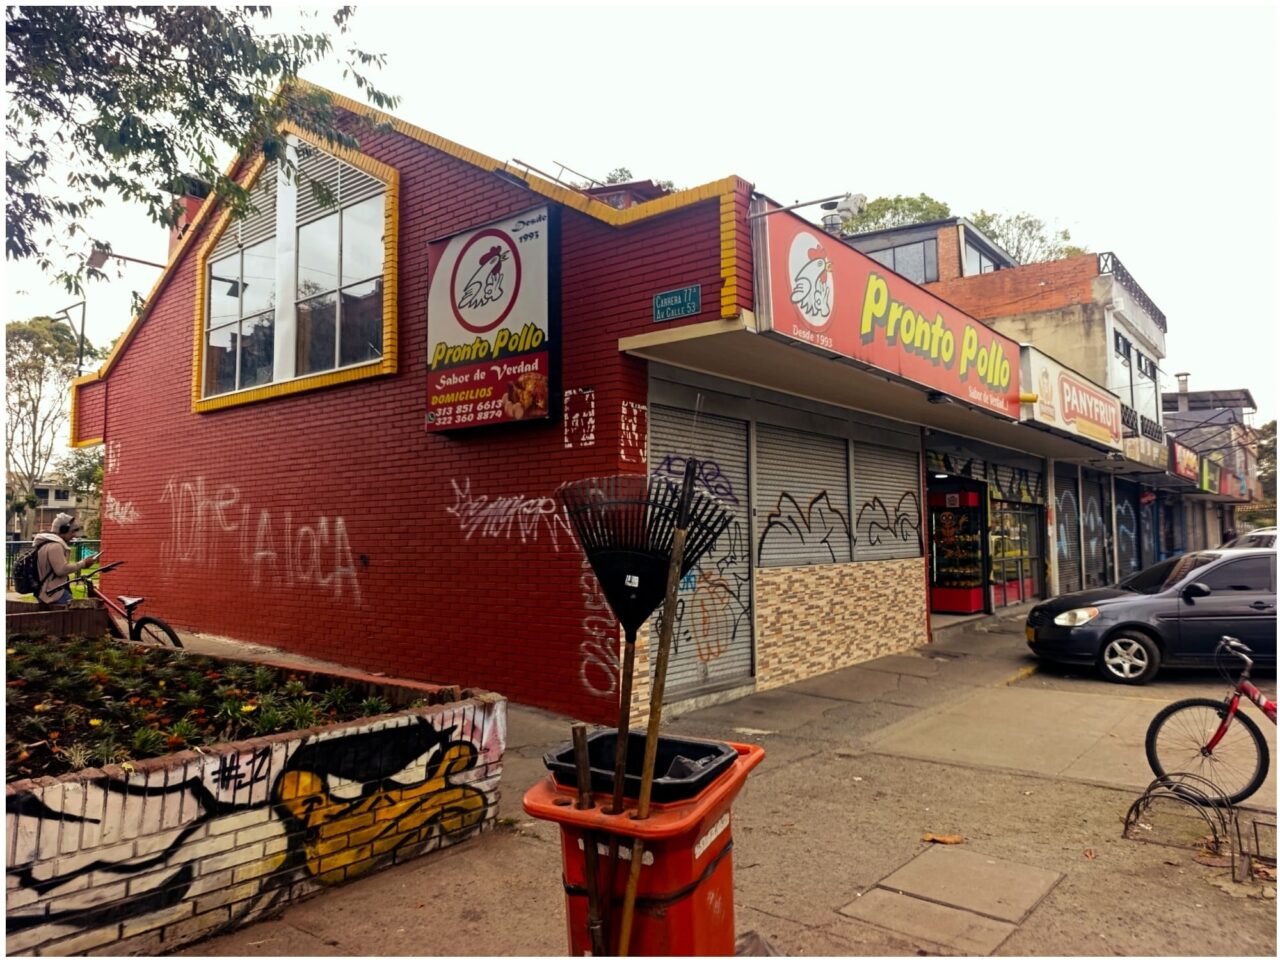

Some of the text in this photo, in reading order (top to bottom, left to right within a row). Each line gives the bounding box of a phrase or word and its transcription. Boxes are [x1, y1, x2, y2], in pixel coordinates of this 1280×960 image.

[793, 324, 833, 348] Desde 1993
[860, 272, 1011, 388] Pronto Pollo
[431, 322, 545, 370] Pronto Pollo
[435, 358, 539, 390] Sabor de Verdad
[431, 386, 494, 405] DOMICILIOS
[435, 399, 503, 416] 313 851 6613
[1063, 381, 1117, 434] PANYFRUT
[435, 415, 452, 426] 322
[455, 412, 474, 423] 360
